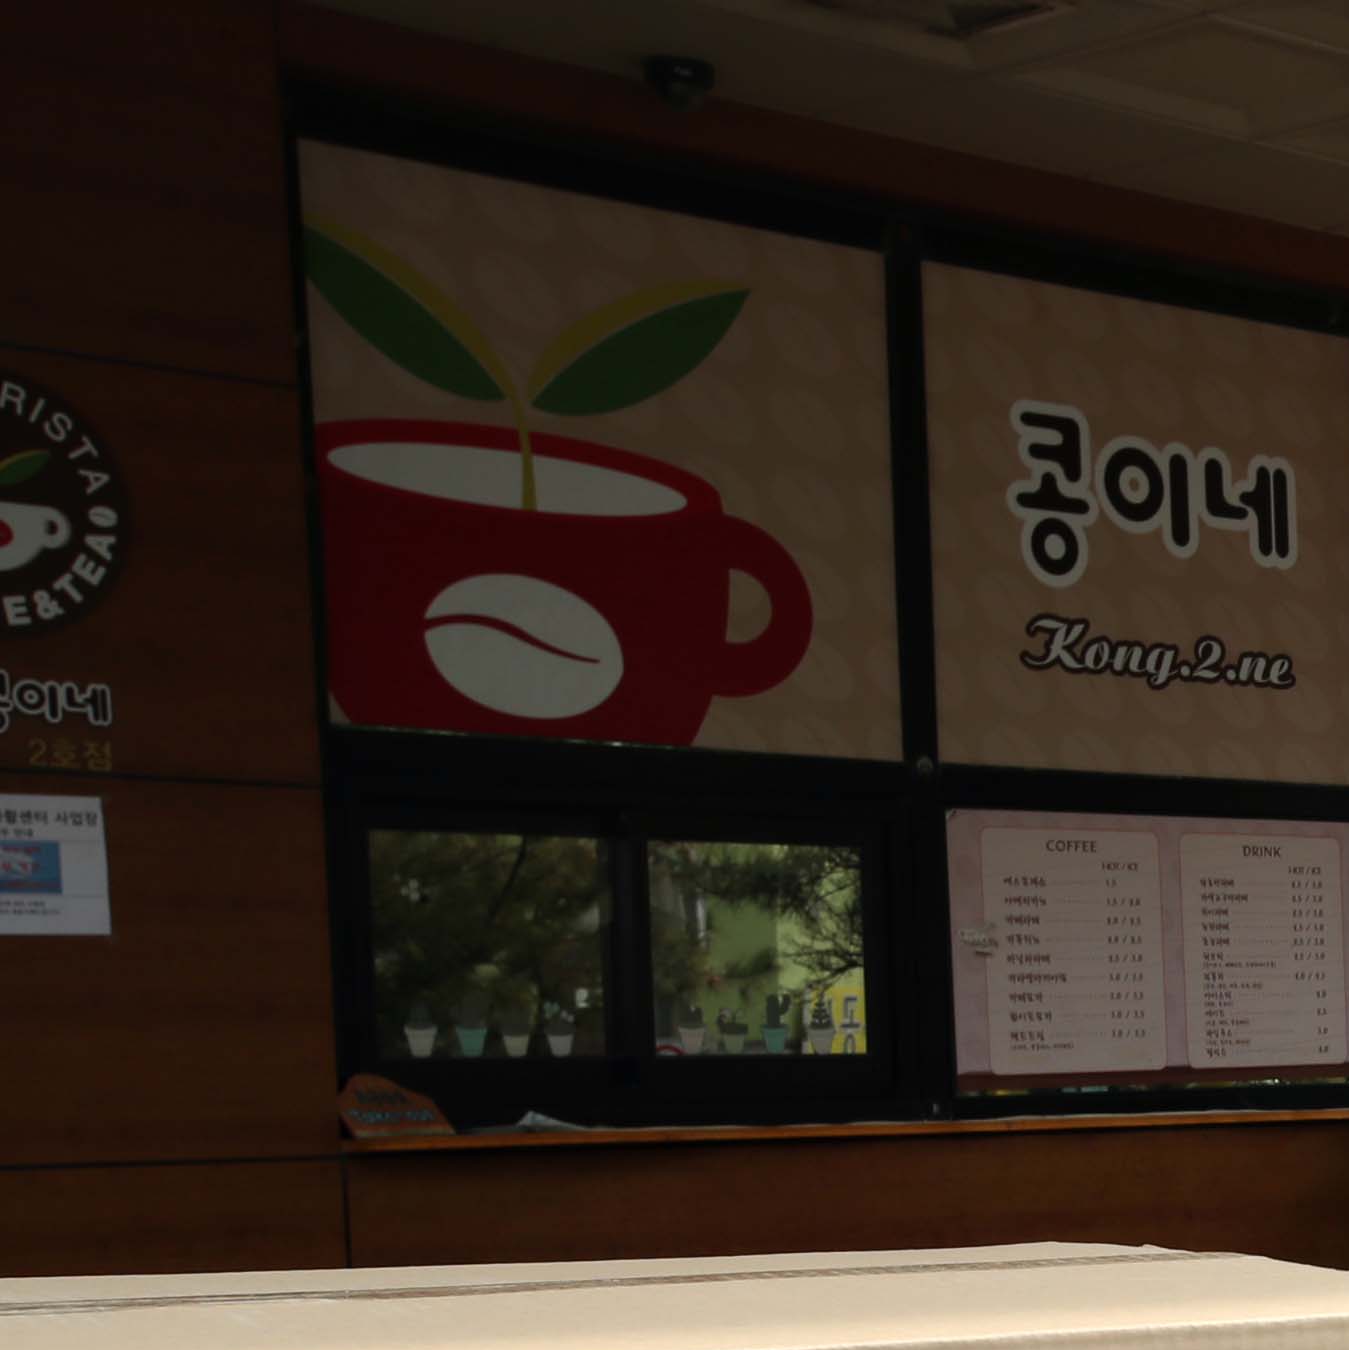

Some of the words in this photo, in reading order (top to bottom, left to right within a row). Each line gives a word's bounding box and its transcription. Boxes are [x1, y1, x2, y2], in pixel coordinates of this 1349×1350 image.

[1010, 403, 1296, 583] 콩이네
[1020, 613, 1296, 689] Kong.2.ne
[27, 738, 113, 772] 2호점
[1045, 840, 1098, 853] COFFEE
[1242, 846, 1282, 858] DRINK
